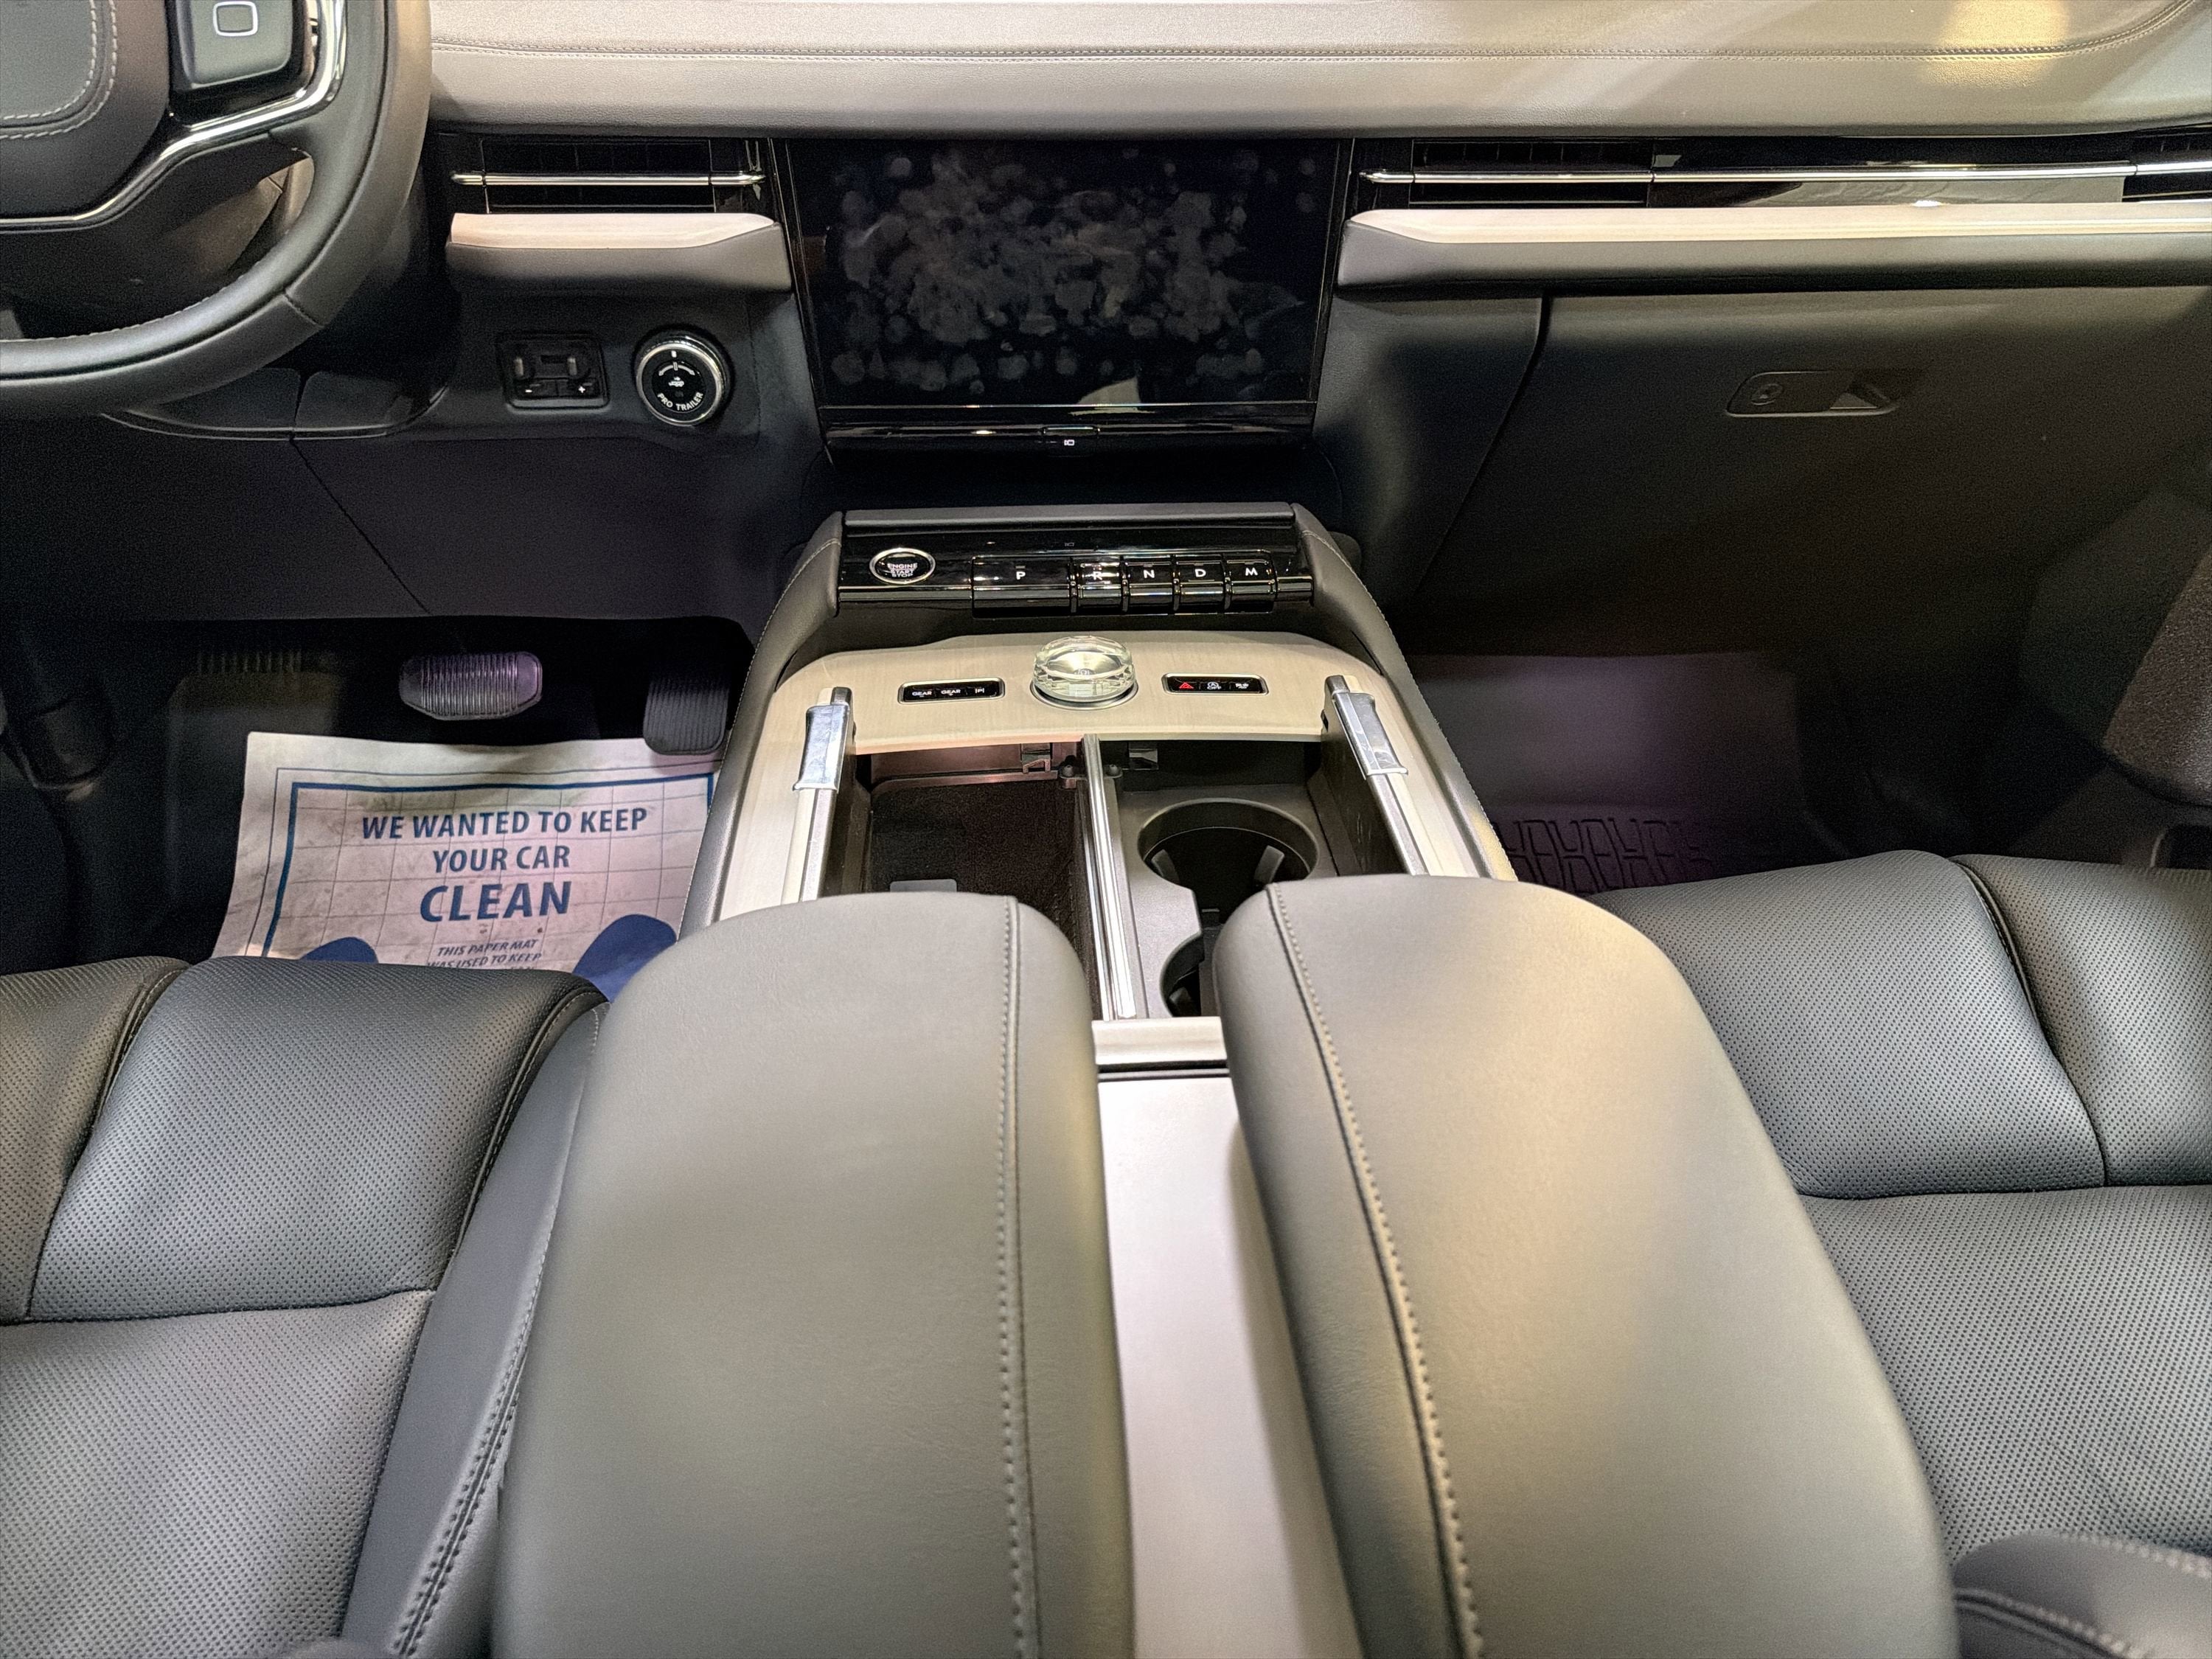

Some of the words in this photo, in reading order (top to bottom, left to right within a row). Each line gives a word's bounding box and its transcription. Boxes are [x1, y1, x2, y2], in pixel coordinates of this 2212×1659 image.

[657, 393, 673, 408] PRO
[675, 392, 703, 411] TRAILER
[1016, 571, 1026, 580] P
[1093, 571, 1103, 580] R
[1143, 569, 1155, 578] N
[1194, 568, 1206, 577] D
[1245, 567, 1258, 576] M
[362, 815, 404, 839] WE
[412, 811, 530, 838] WANTED
[538, 810, 572, 834] TO
[580, 807, 647, 833] KEEP
[433, 848, 508, 874] YOUR
[516, 845, 571, 869] CAR
[420, 881, 572, 923] CLEAN
[437, 945, 467, 956] THIS
[467, 942, 509, 954] PAPER
[510, 939, 539, 950] MAT
[456, 956, 489, 968] USED
[491, 954, 507, 964] TO
[508, 952, 542, 962] KEEP
